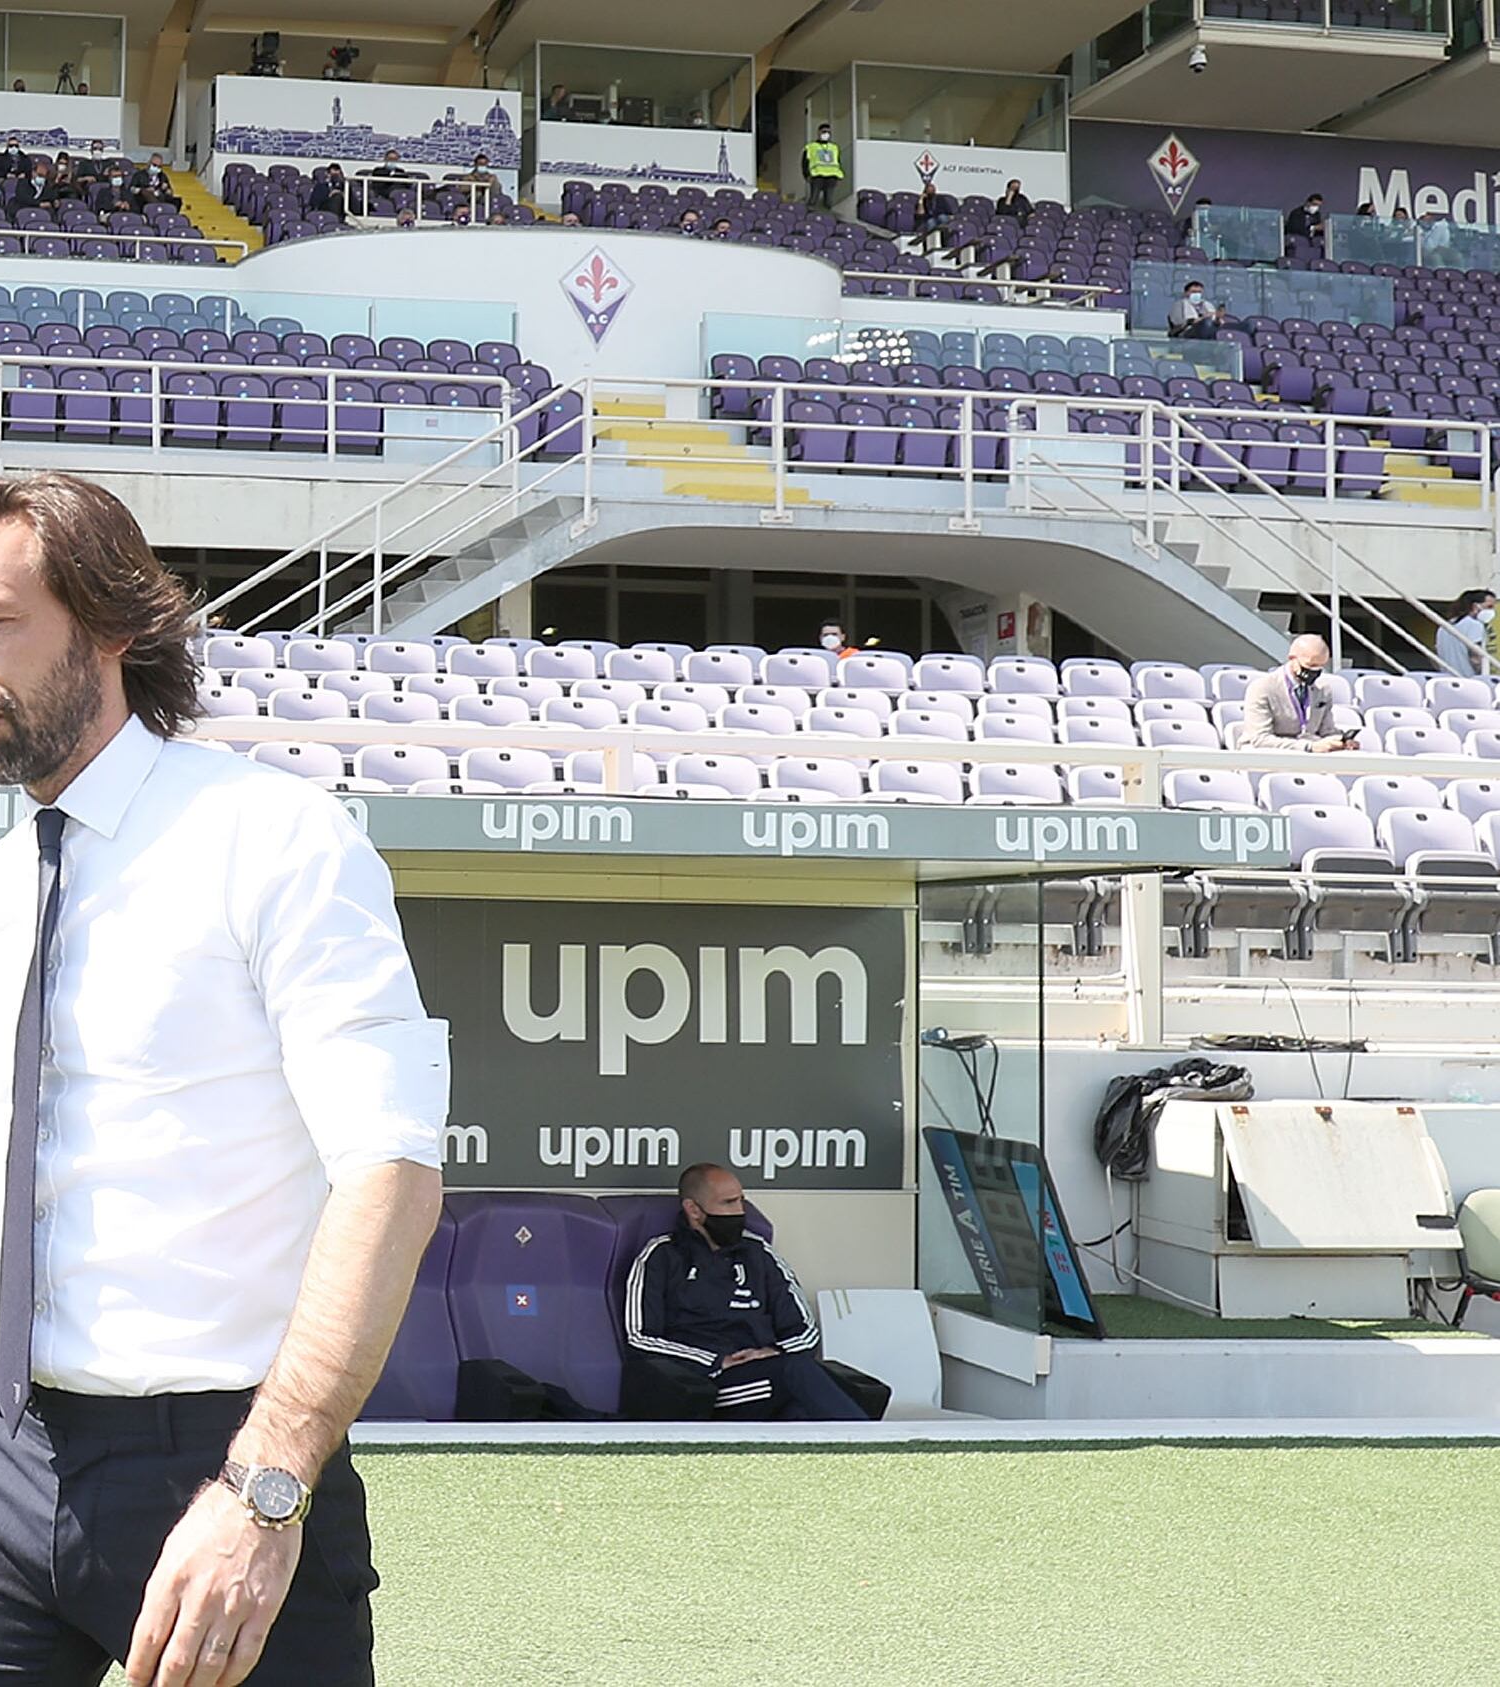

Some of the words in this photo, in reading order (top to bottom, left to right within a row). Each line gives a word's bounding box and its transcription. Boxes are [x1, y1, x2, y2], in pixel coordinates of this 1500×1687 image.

[482, 803, 632, 850] upim
[743, 812, 889, 855] upim
[996, 817, 1137, 861] upim
[1200, 817, 1290, 862] upi
[503, 944, 867, 1075] upim
[540, 1127, 679, 1177] upim
[730, 1129, 865, 1179] upim
[943, 1164, 965, 1200] TIM
[956, 1208, 980, 1235] A
[971, 1238, 1003, 1299] SERIE
